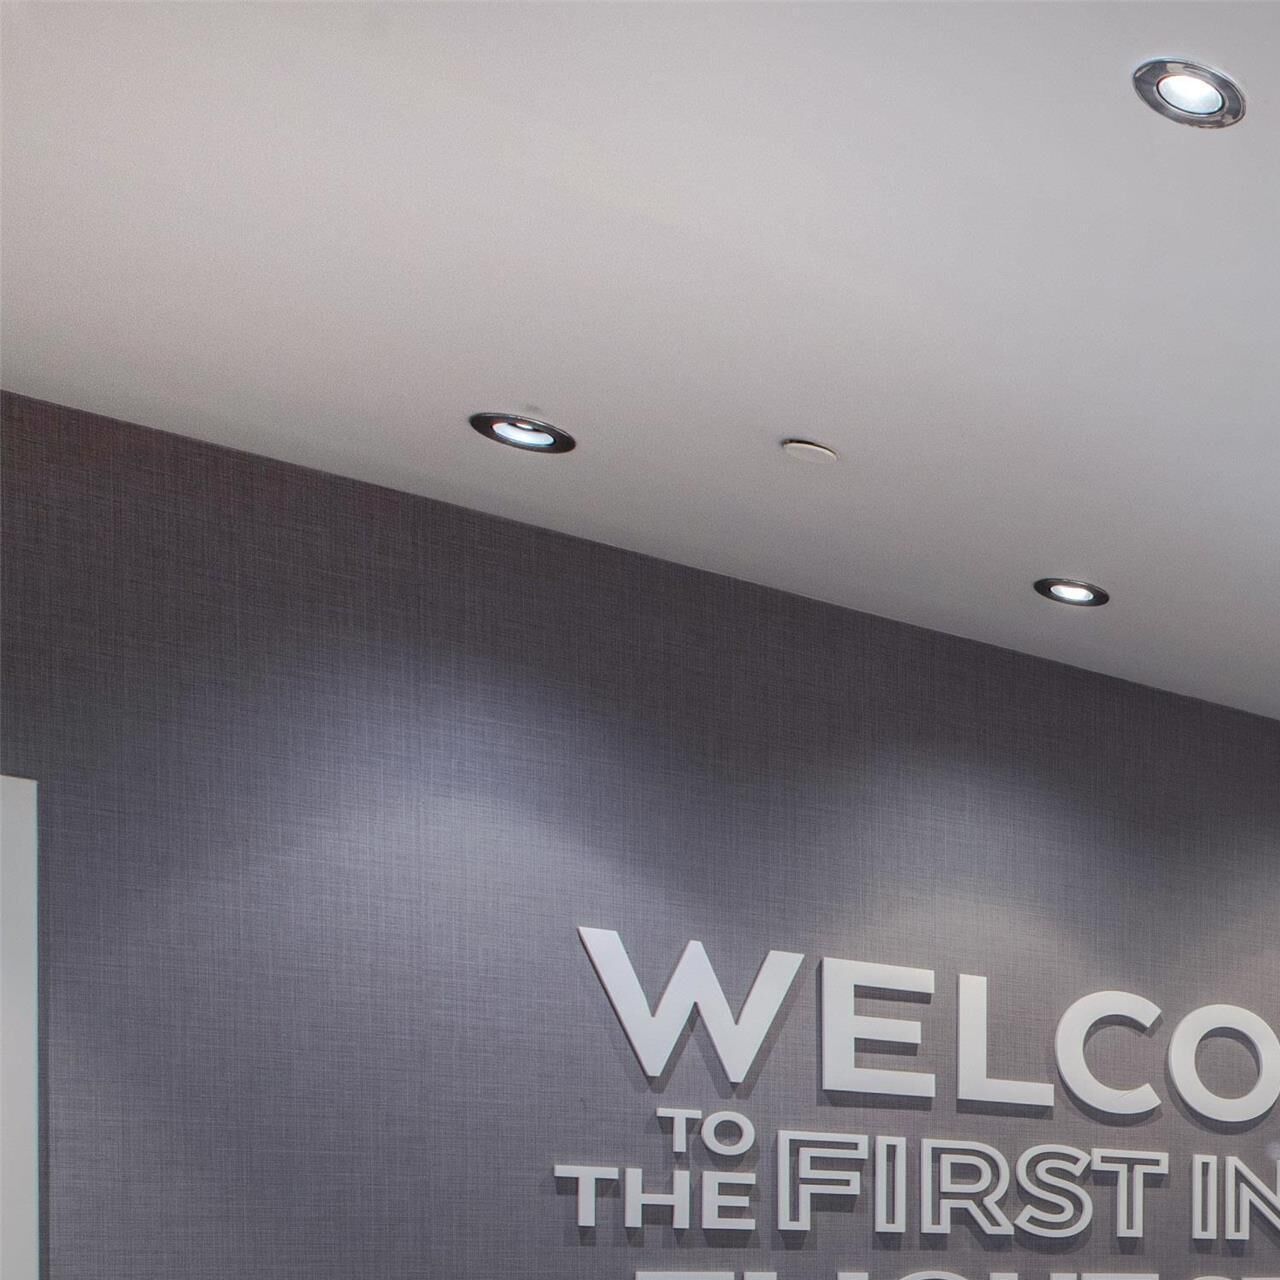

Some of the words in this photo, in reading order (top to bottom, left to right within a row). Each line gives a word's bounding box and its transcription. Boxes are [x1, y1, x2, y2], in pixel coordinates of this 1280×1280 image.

[656, 1107, 757, 1158] TO
[553, 1164, 758, 1232] THE
[776, 1130, 1169, 1239] FIRST
